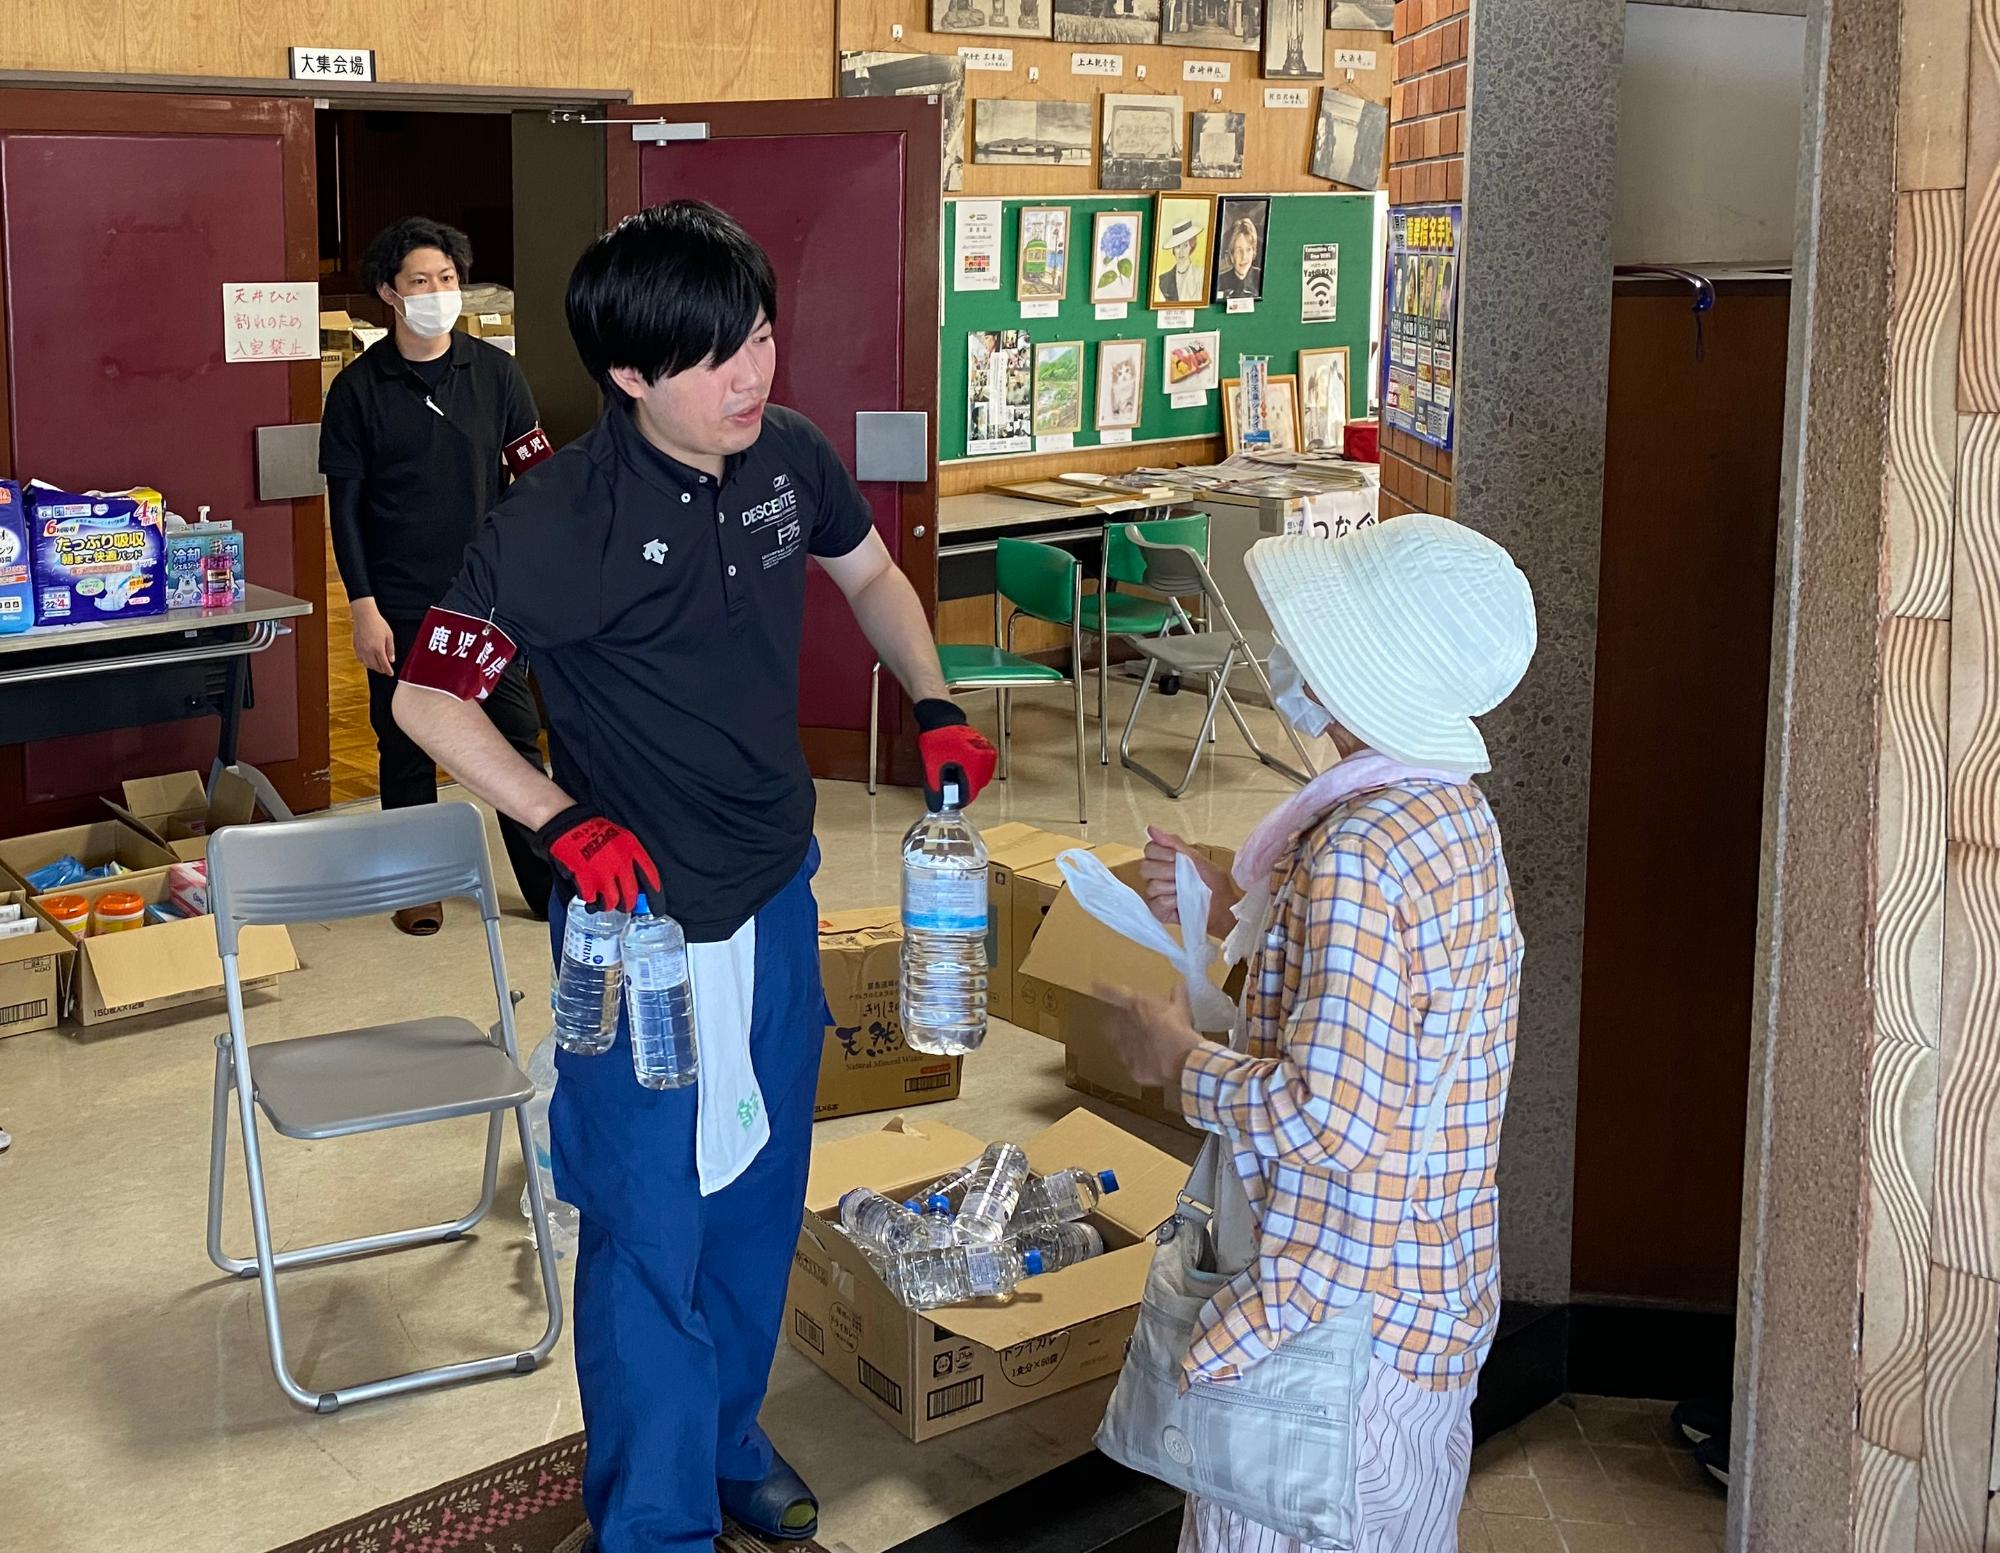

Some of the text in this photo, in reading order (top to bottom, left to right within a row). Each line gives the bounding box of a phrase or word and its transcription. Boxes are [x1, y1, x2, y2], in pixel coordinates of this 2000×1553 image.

[301, 53, 364, 76] 大集会場
[234, 288, 299, 304] 天井ひび
[234, 313, 302, 330] 割れのため
[233, 338, 306, 356] 入室禁止
[516, 434, 550, 460] 鹿児
[56, 531, 145, 552] たっぷり吸収
[173, 547, 201, 562] 冷却
[428, 625, 508, 679] 鹿児島県
[582, 933, 593, 963] KIRIN
[845, 1060, 872, 1071] Natural
